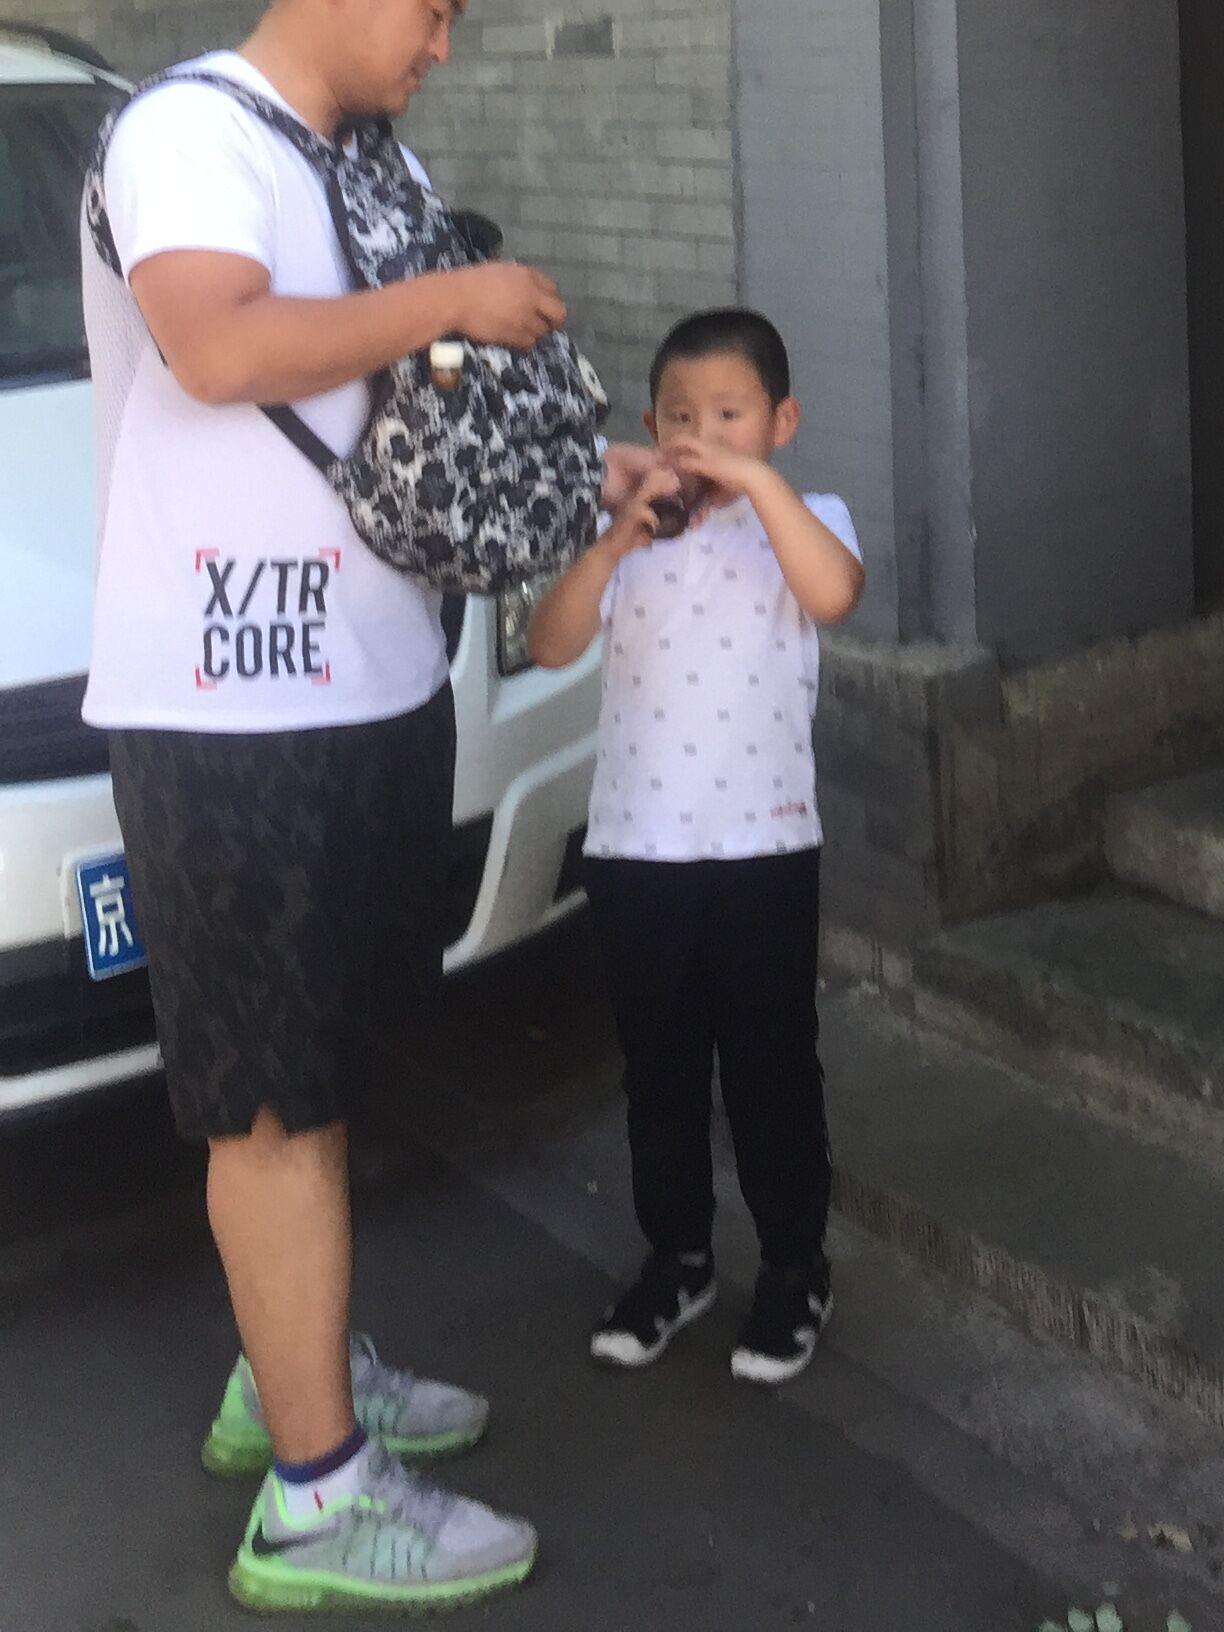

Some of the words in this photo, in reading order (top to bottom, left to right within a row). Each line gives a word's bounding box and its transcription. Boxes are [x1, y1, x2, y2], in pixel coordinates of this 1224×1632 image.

[204, 558, 331, 618] X/TR
[203, 620, 327, 679] CORE
[89, 873, 136, 958] 京
